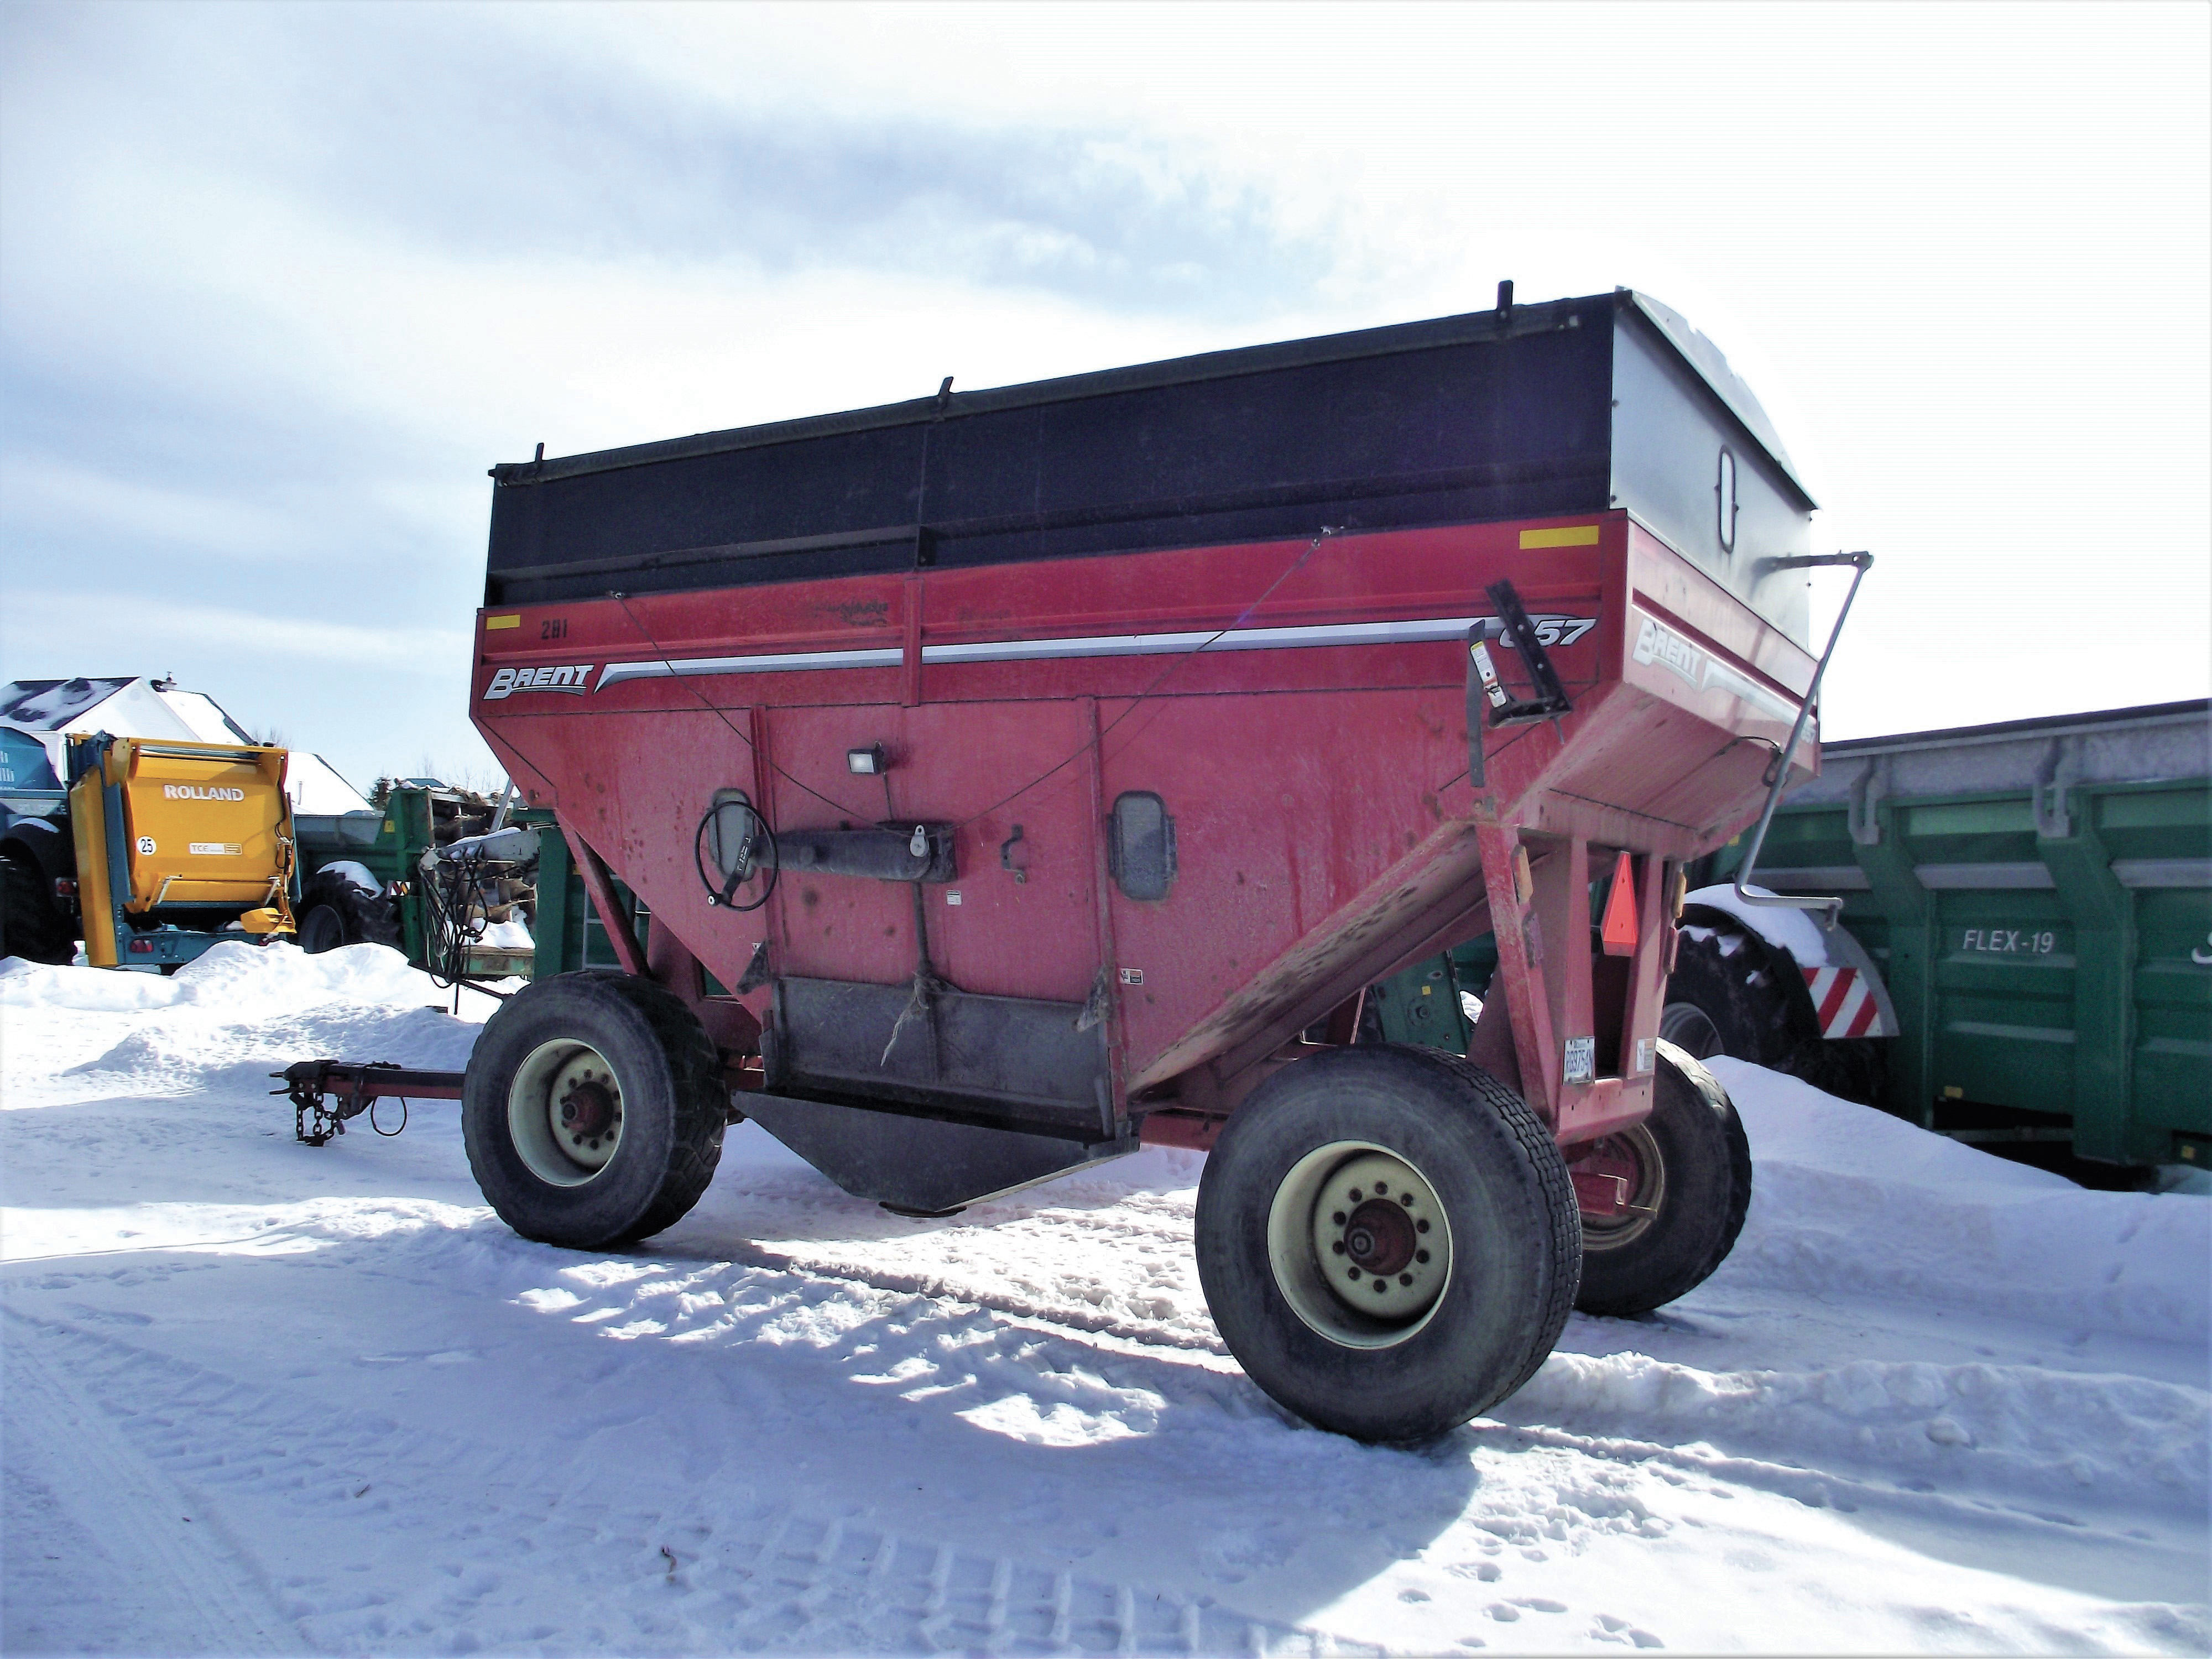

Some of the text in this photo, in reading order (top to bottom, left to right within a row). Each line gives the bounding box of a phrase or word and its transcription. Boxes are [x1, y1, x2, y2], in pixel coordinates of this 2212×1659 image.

[1632, 618, 1702, 680] BRENT
[483, 664, 595, 700] BRENT
[164, 784, 245, 801] ROLLAND
[140, 838, 153, 853] 25
[1963, 929, 2054, 954] FLEX-19
